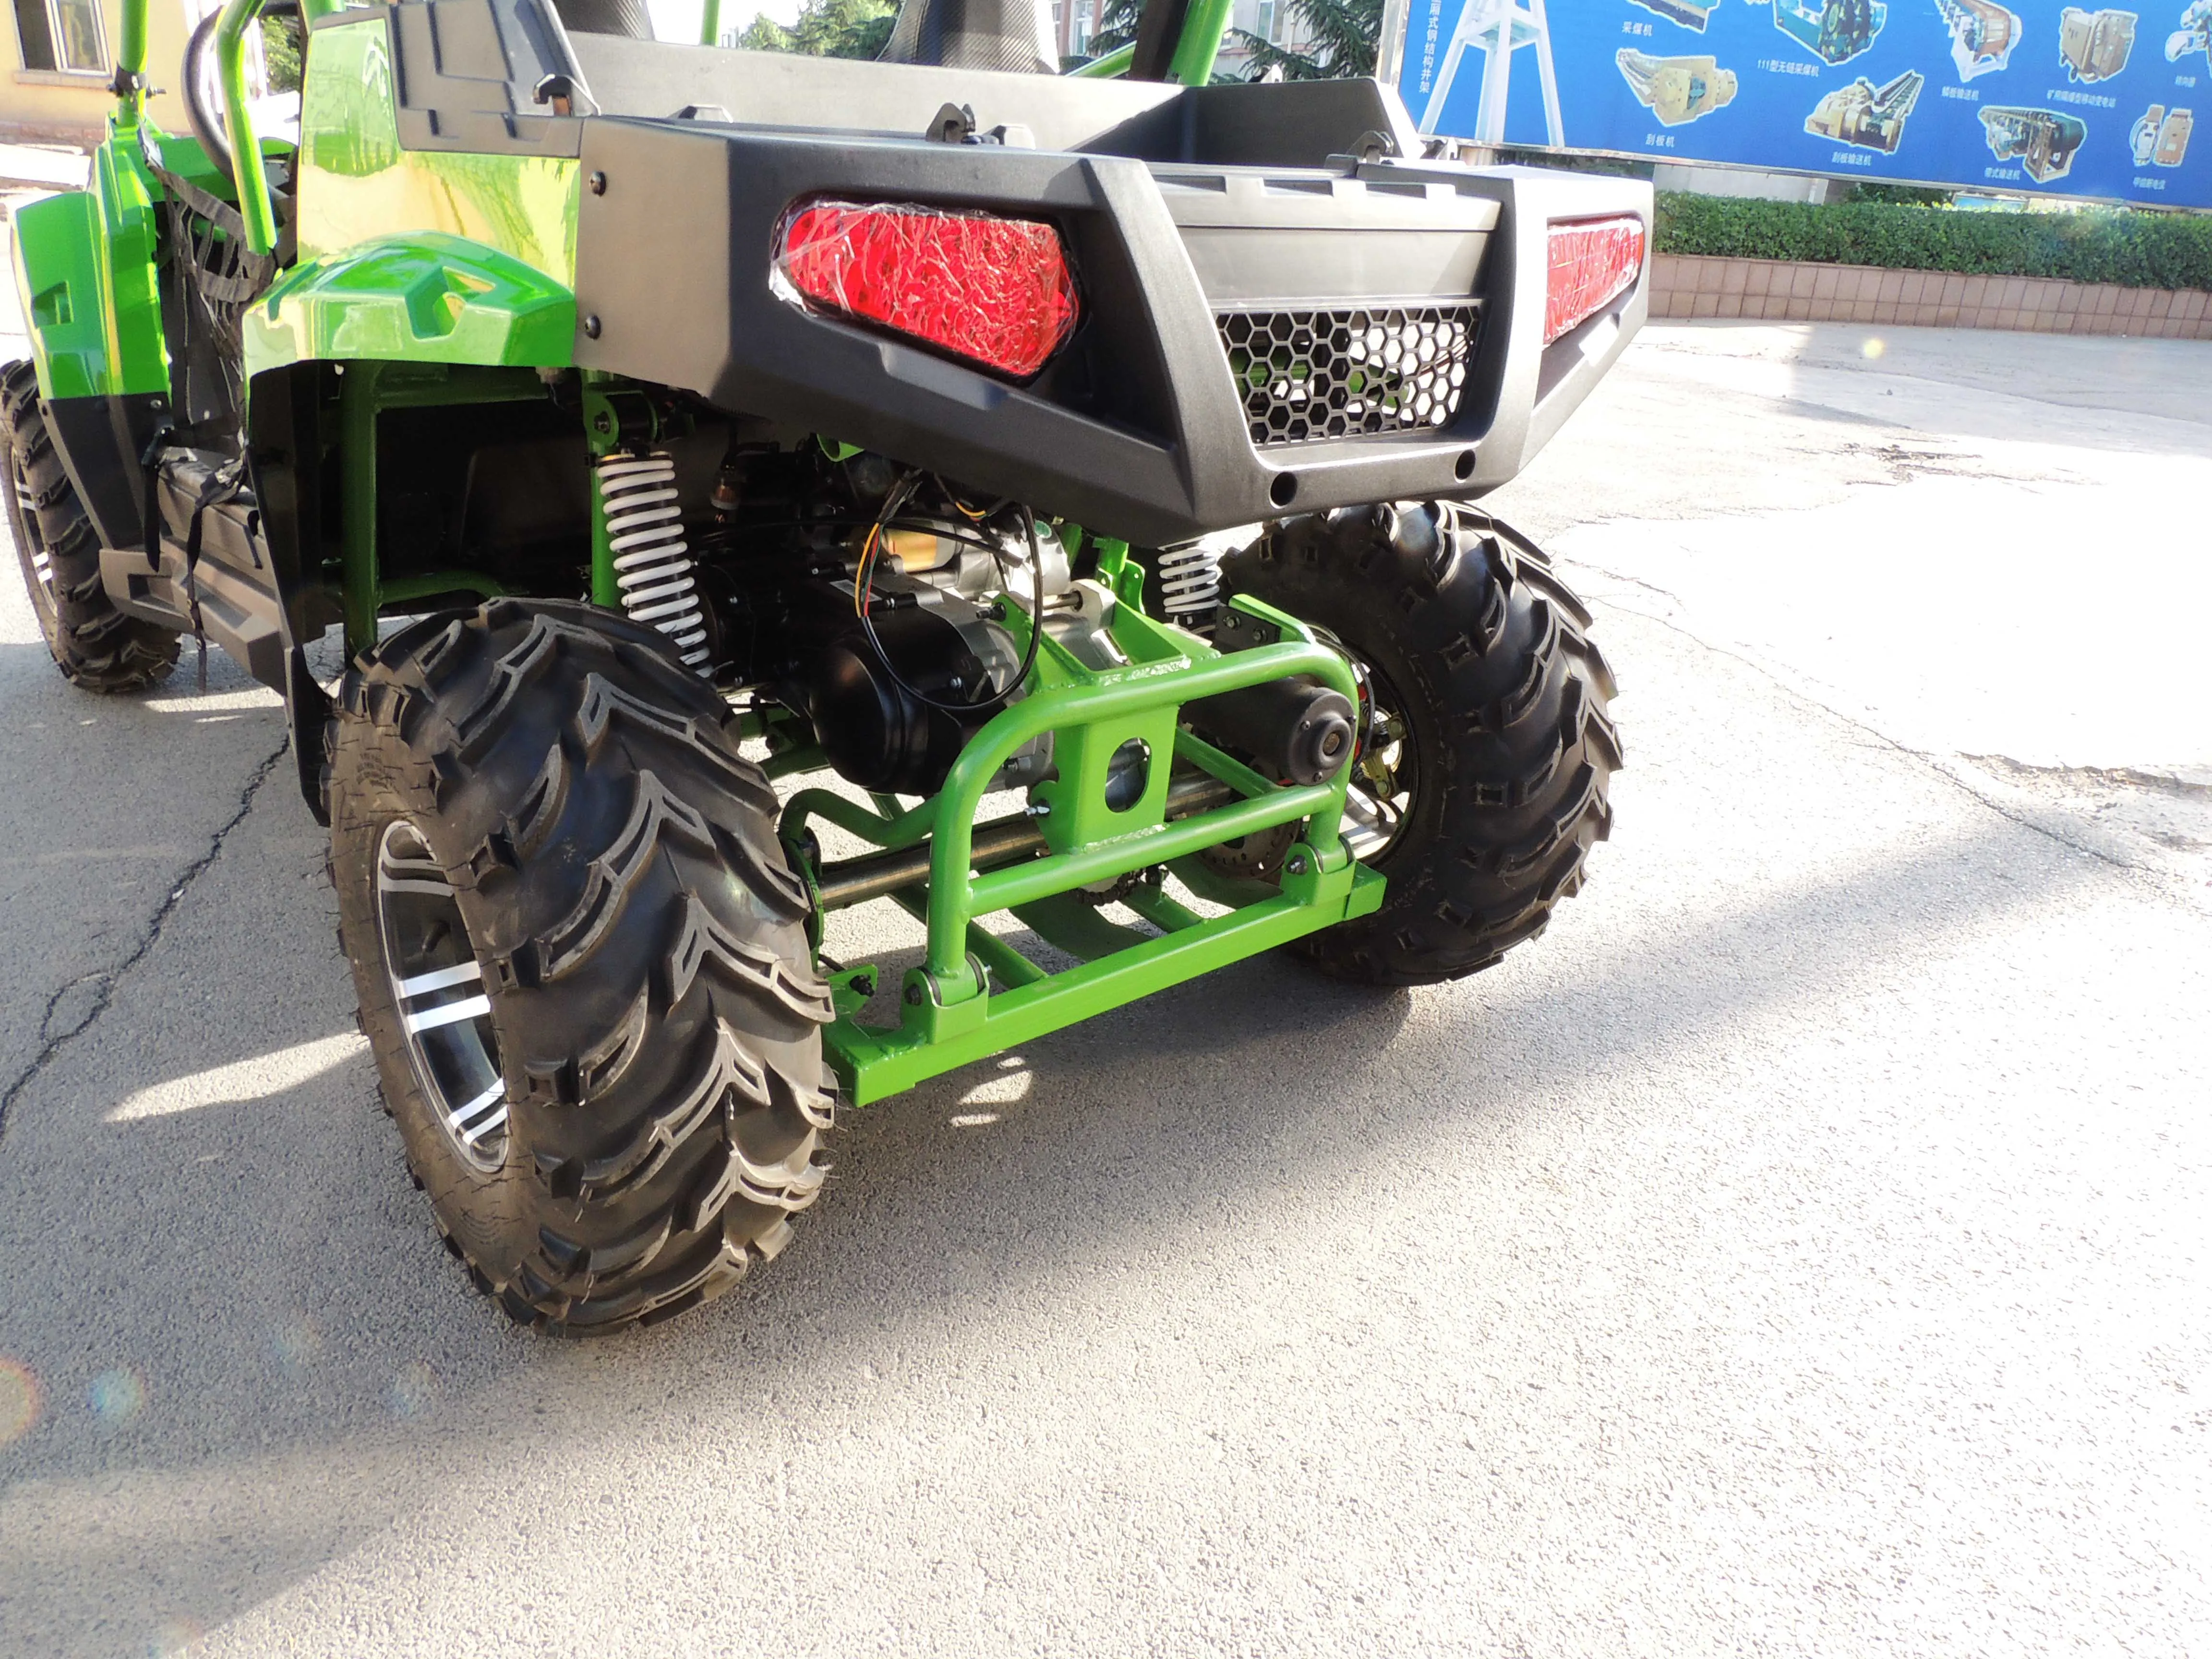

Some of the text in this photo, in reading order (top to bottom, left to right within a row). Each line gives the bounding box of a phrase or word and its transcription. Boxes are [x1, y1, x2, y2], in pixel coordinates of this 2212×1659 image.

[1419, 0, 1442, 93] 厢式钢结构井架
